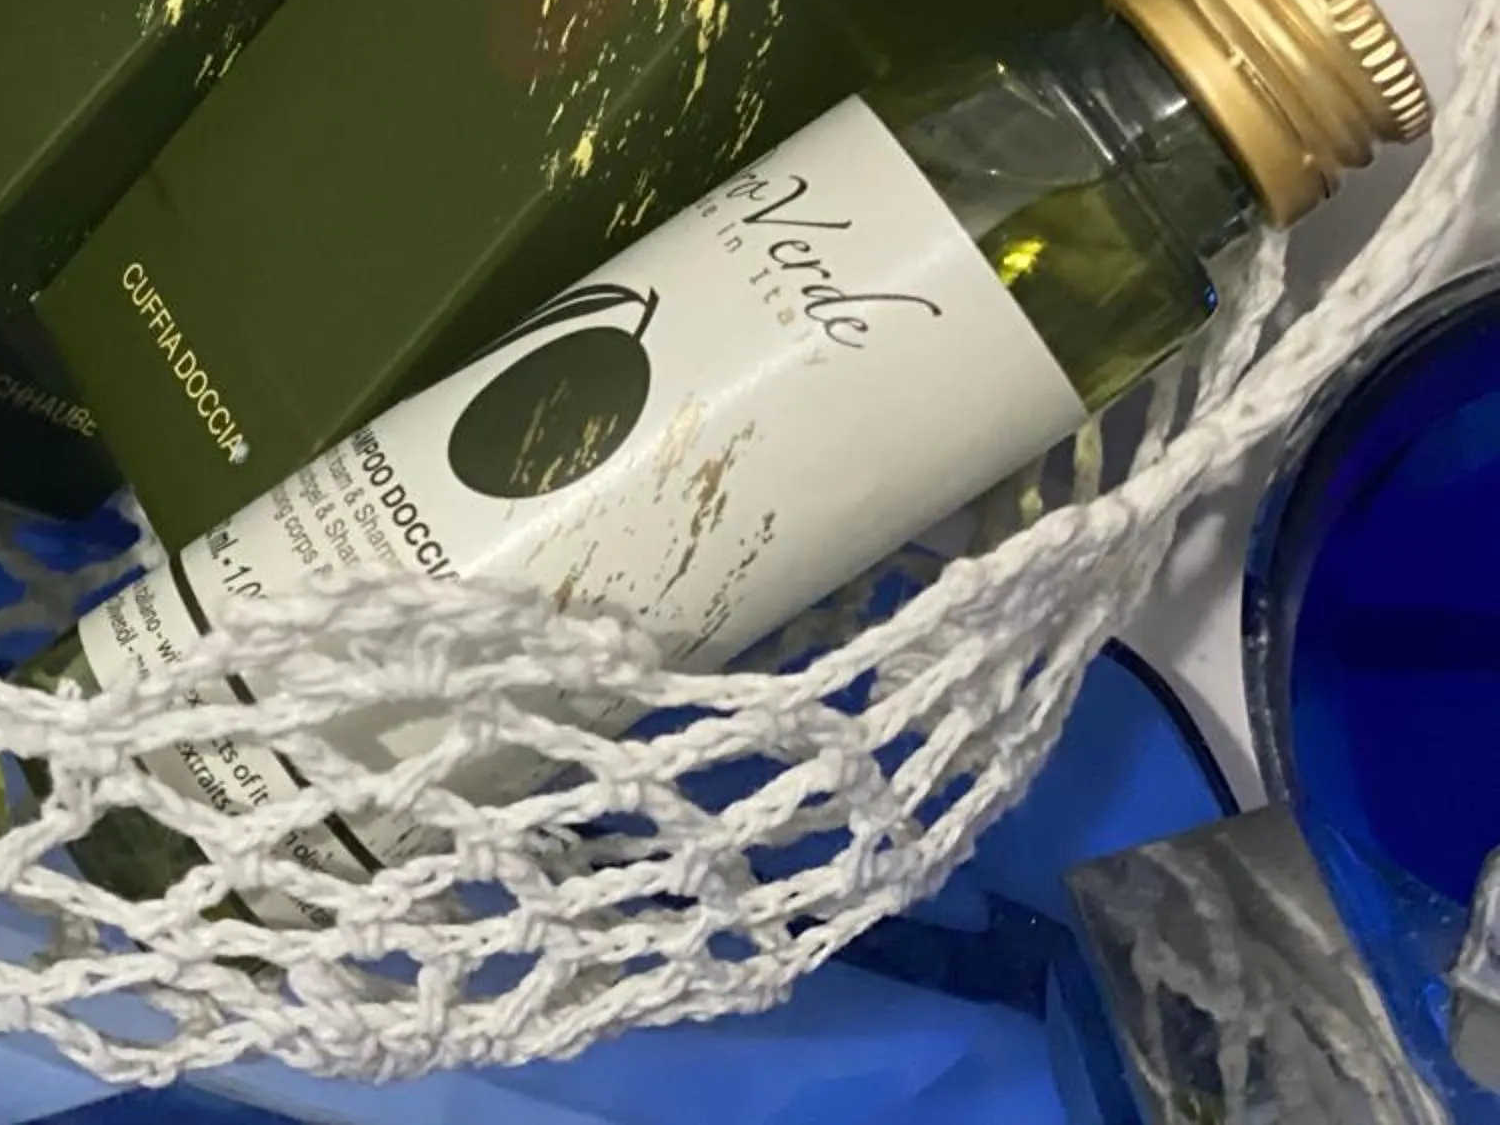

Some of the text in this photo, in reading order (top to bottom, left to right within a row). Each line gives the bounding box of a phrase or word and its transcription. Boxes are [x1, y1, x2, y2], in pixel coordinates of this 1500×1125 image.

[716, 222, 743, 254] in
[122, 262, 246, 464] CUFFIA DOCCIA
[284, 515, 320, 565] corps
[233, 764, 262, 788] of
